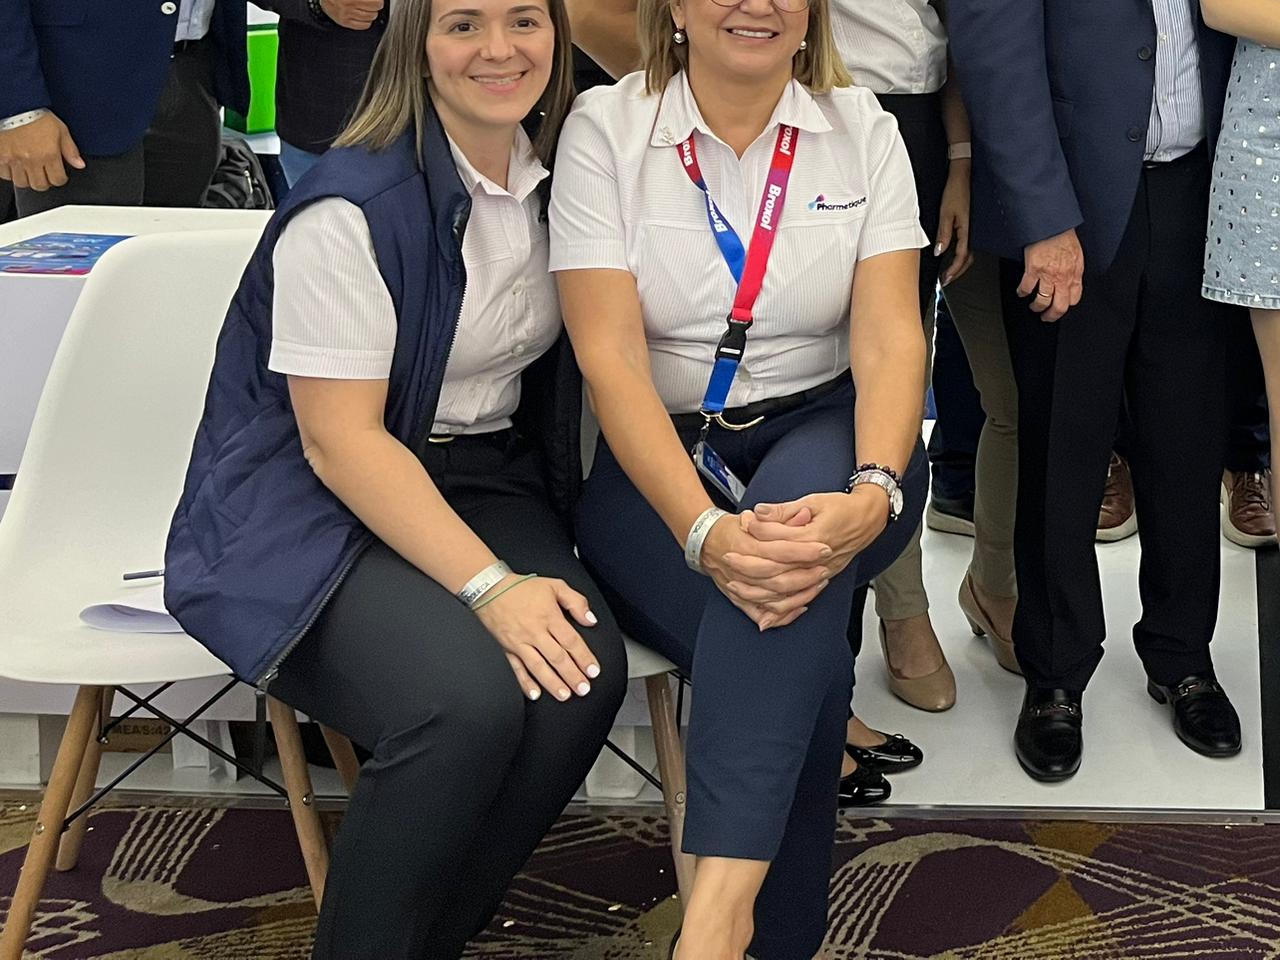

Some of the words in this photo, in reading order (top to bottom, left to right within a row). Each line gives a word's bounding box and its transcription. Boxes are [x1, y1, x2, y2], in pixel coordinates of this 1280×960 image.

[779, 125, 793, 156] oxol
[760, 183, 782, 231] Broxol
[816, 196, 867, 211] Pharmetique
